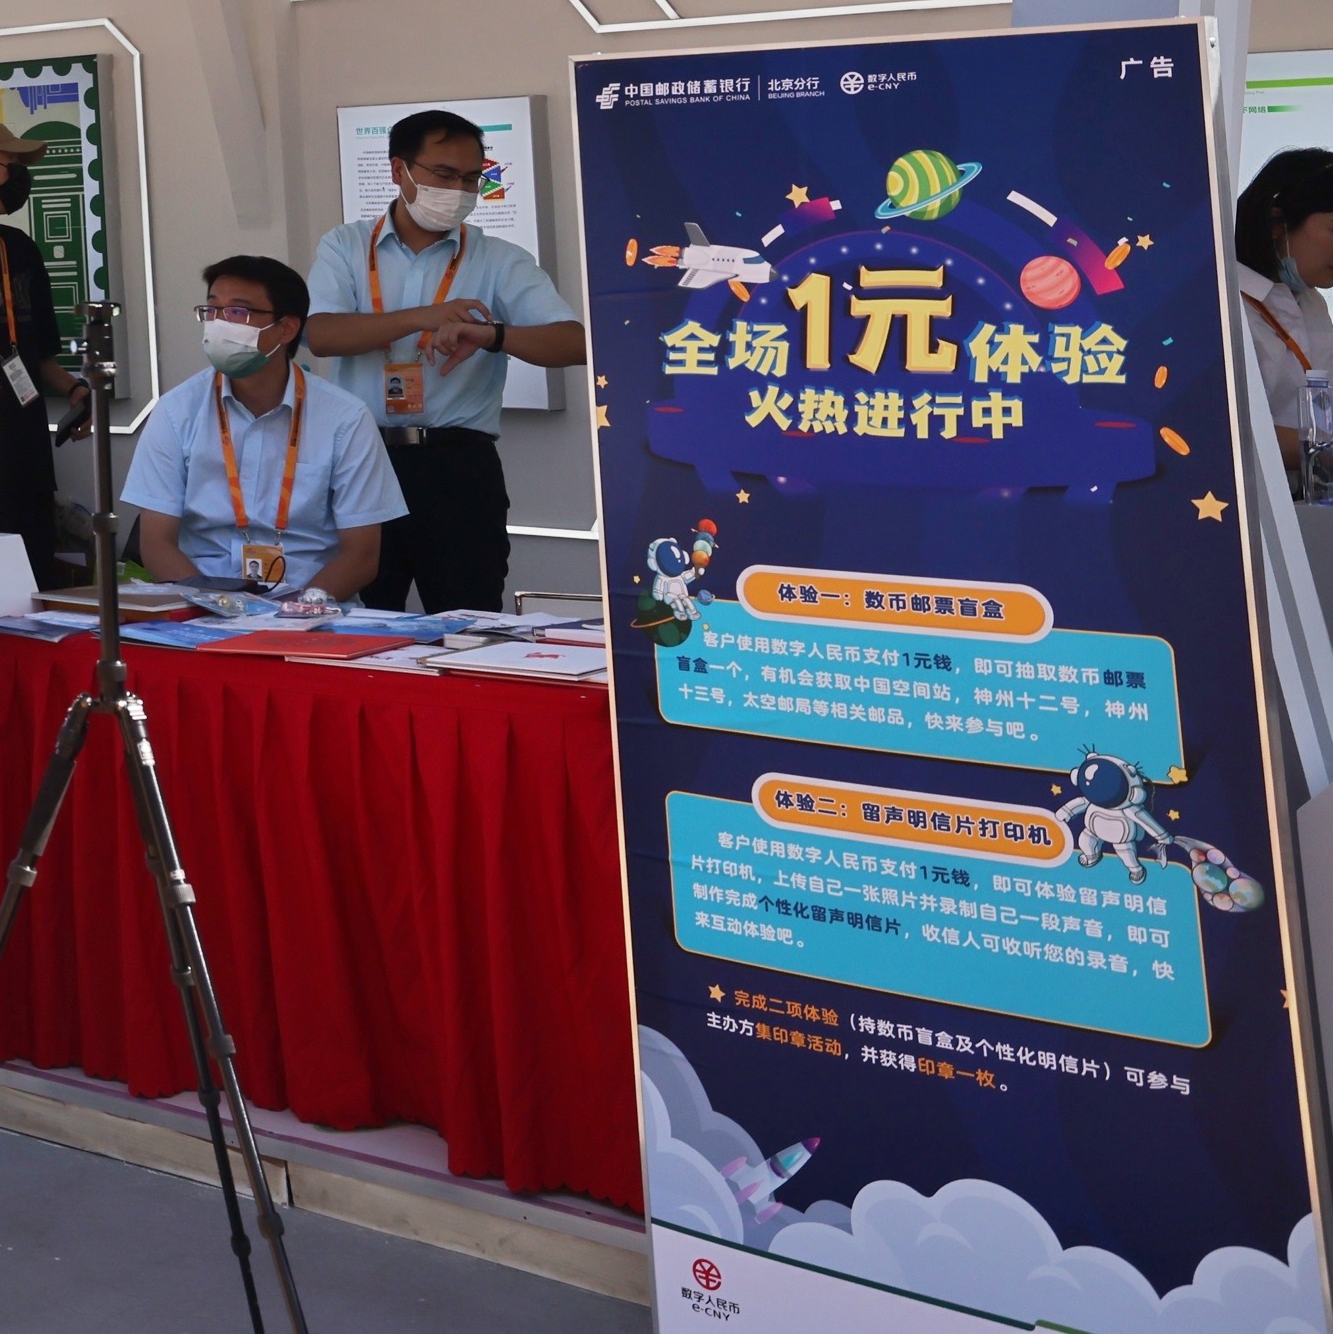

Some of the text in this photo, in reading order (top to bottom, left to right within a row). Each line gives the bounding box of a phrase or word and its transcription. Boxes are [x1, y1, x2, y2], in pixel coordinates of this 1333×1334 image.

[625, 77, 750, 97] 中国邮政储蓄银行
[767, 77, 820, 91] 北京分行
[867, 72, 917, 82] 数字人民币
[655, 97, 687, 105] SAVINGS
[725, 94, 750, 102] CHINA
[867, 82, 899, 91] e-CNY
[661, 265, 1127, 386] 全场1元体验
[744, 384, 1024, 440] 火热进行中
[778, 582, 1005, 622] 体验一：数币邮票盲盒
[775, 789, 1053, 849] 体验二：留声明信片打印机
[694, 912, 804, 949] 来互动体验吧。
[681, 1287, 740, 1314] 数字人民币
[693, 1302, 730, 1321] e-CNY
